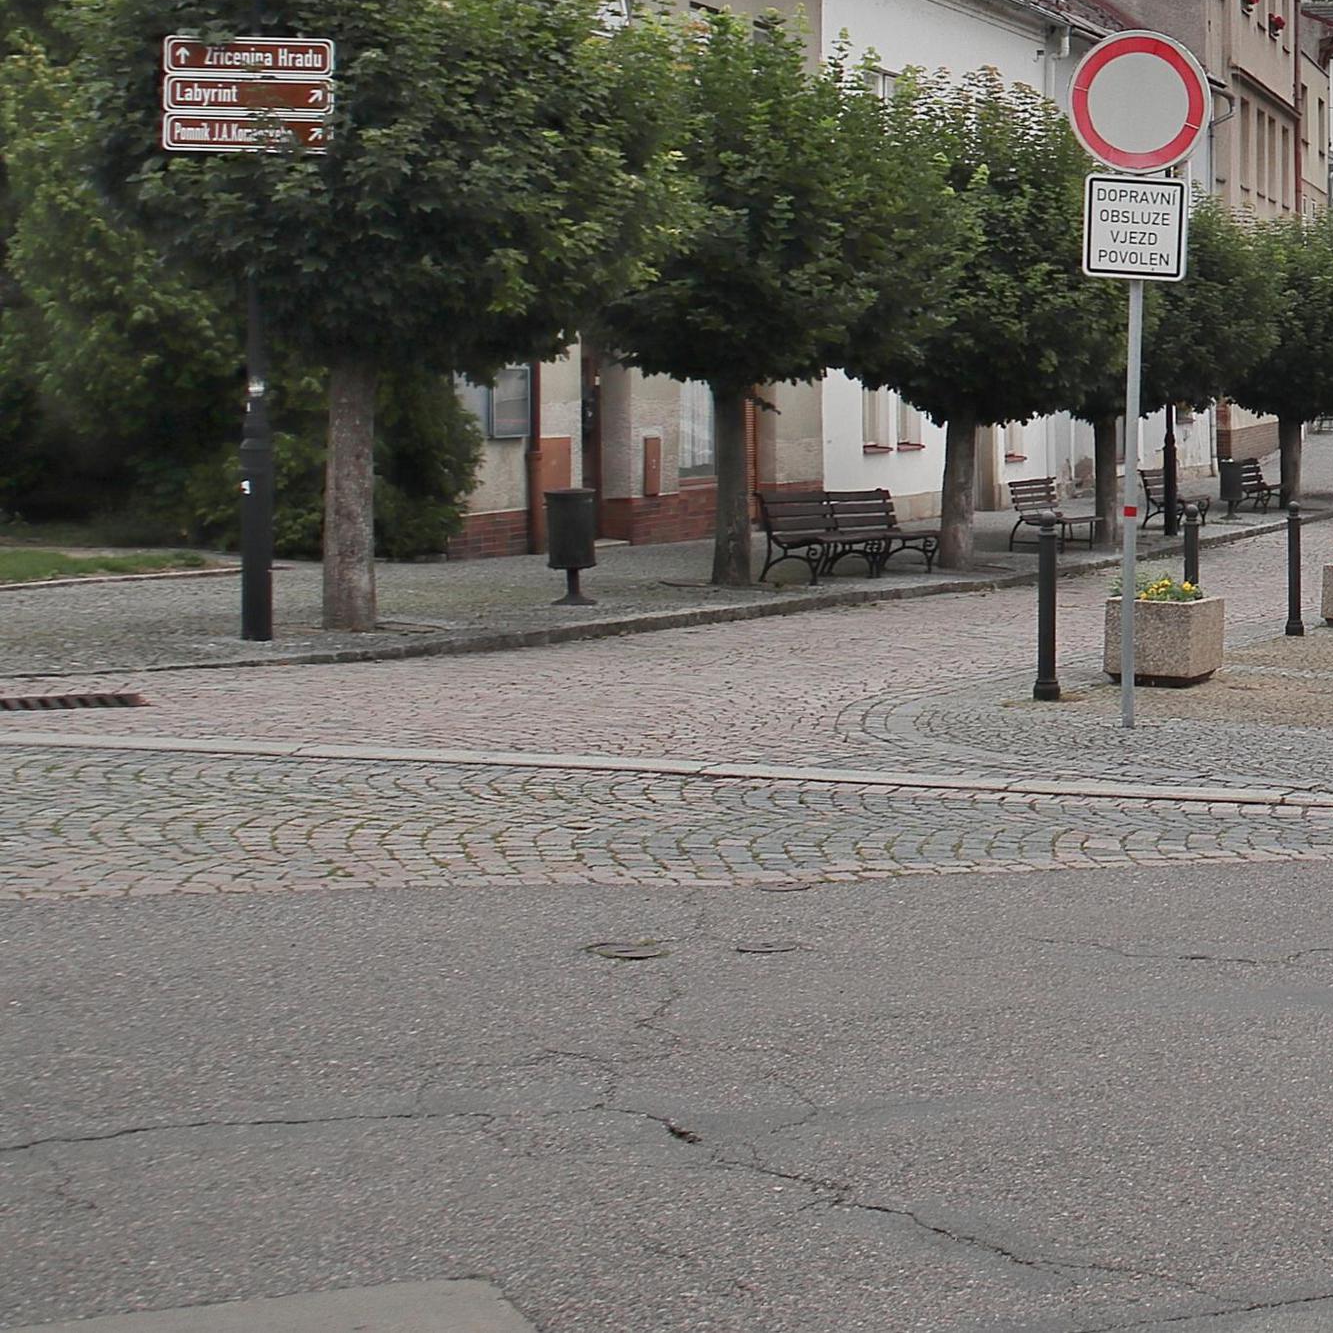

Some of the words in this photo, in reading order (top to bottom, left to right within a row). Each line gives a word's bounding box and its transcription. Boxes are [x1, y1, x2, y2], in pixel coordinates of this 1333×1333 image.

[278, 48, 322, 68] Hradu
[175, 82, 238, 106] Labyrint
[1097, 187, 1177, 206] DOPRAVNÍ
[1099, 208, 1171, 226] OBSLUZE
[1110, 230, 1158, 246] VJEZD
[1098, 249, 1170, 266] POVOLEN
